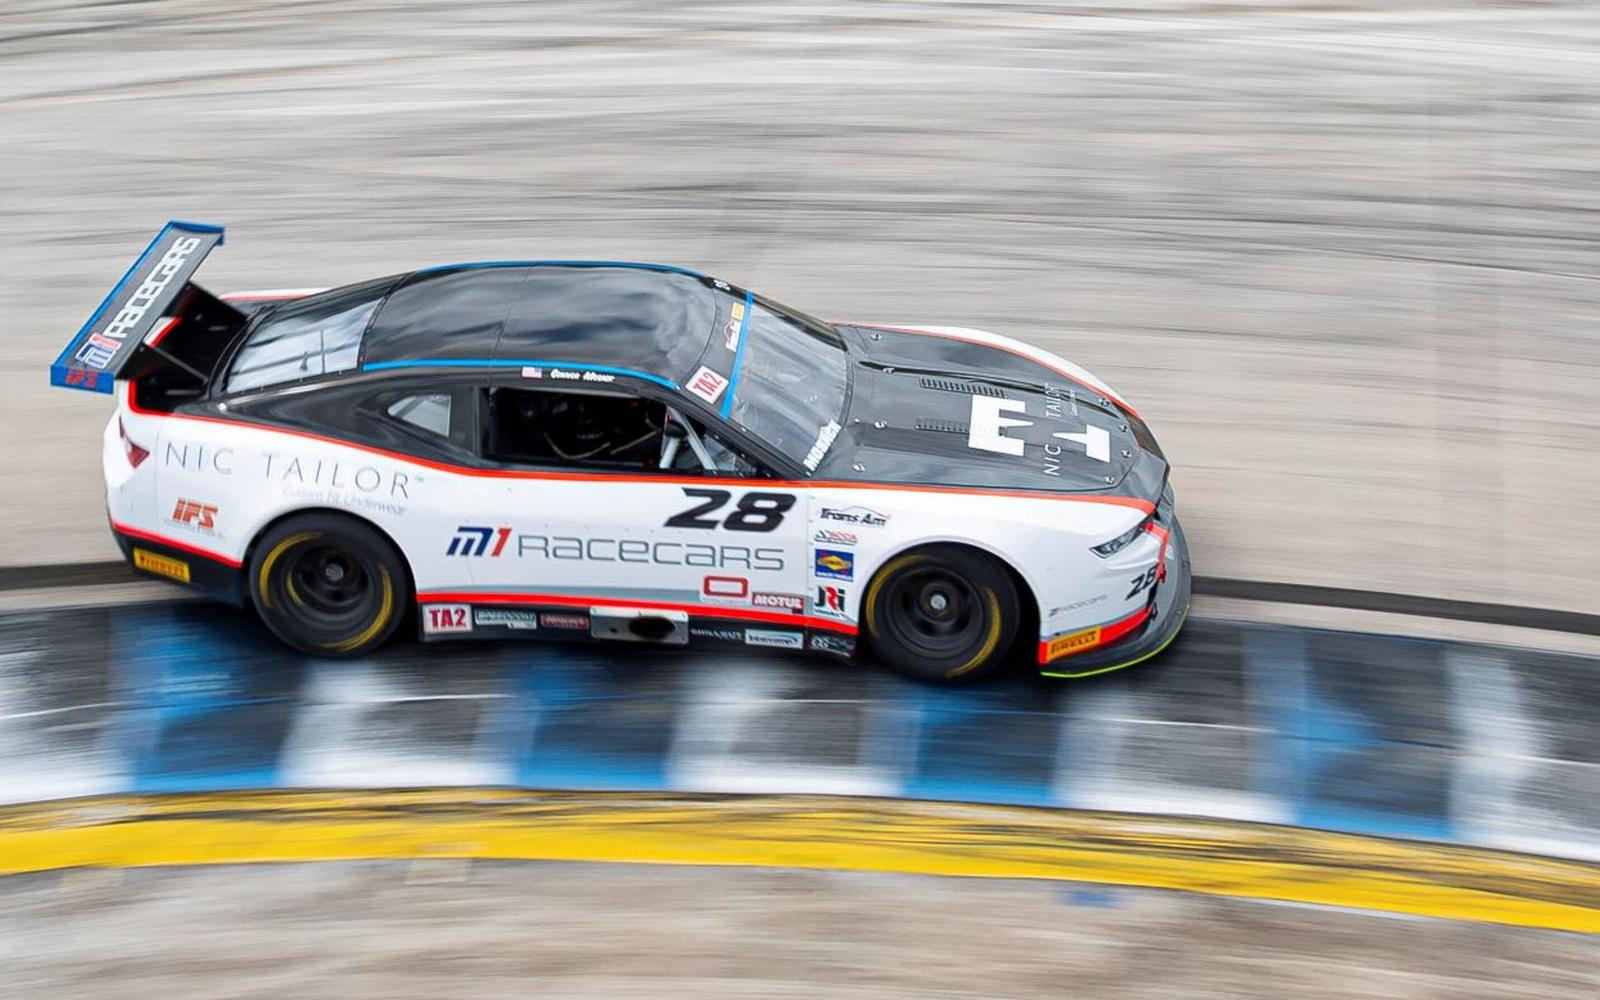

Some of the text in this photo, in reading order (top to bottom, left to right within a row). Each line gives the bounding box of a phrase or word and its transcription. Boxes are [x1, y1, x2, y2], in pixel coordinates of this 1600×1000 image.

[692, 371, 724, 397] TA2
[166, 442, 234, 475] NIC
[1043, 444, 1061, 476] NIC
[172, 497, 218, 529] IFS
[663, 487, 797, 533] 28
[820, 508, 887, 526] Trans Am
[754, 594, 803, 609] MOTUL
[429, 608, 468, 629] TA2
